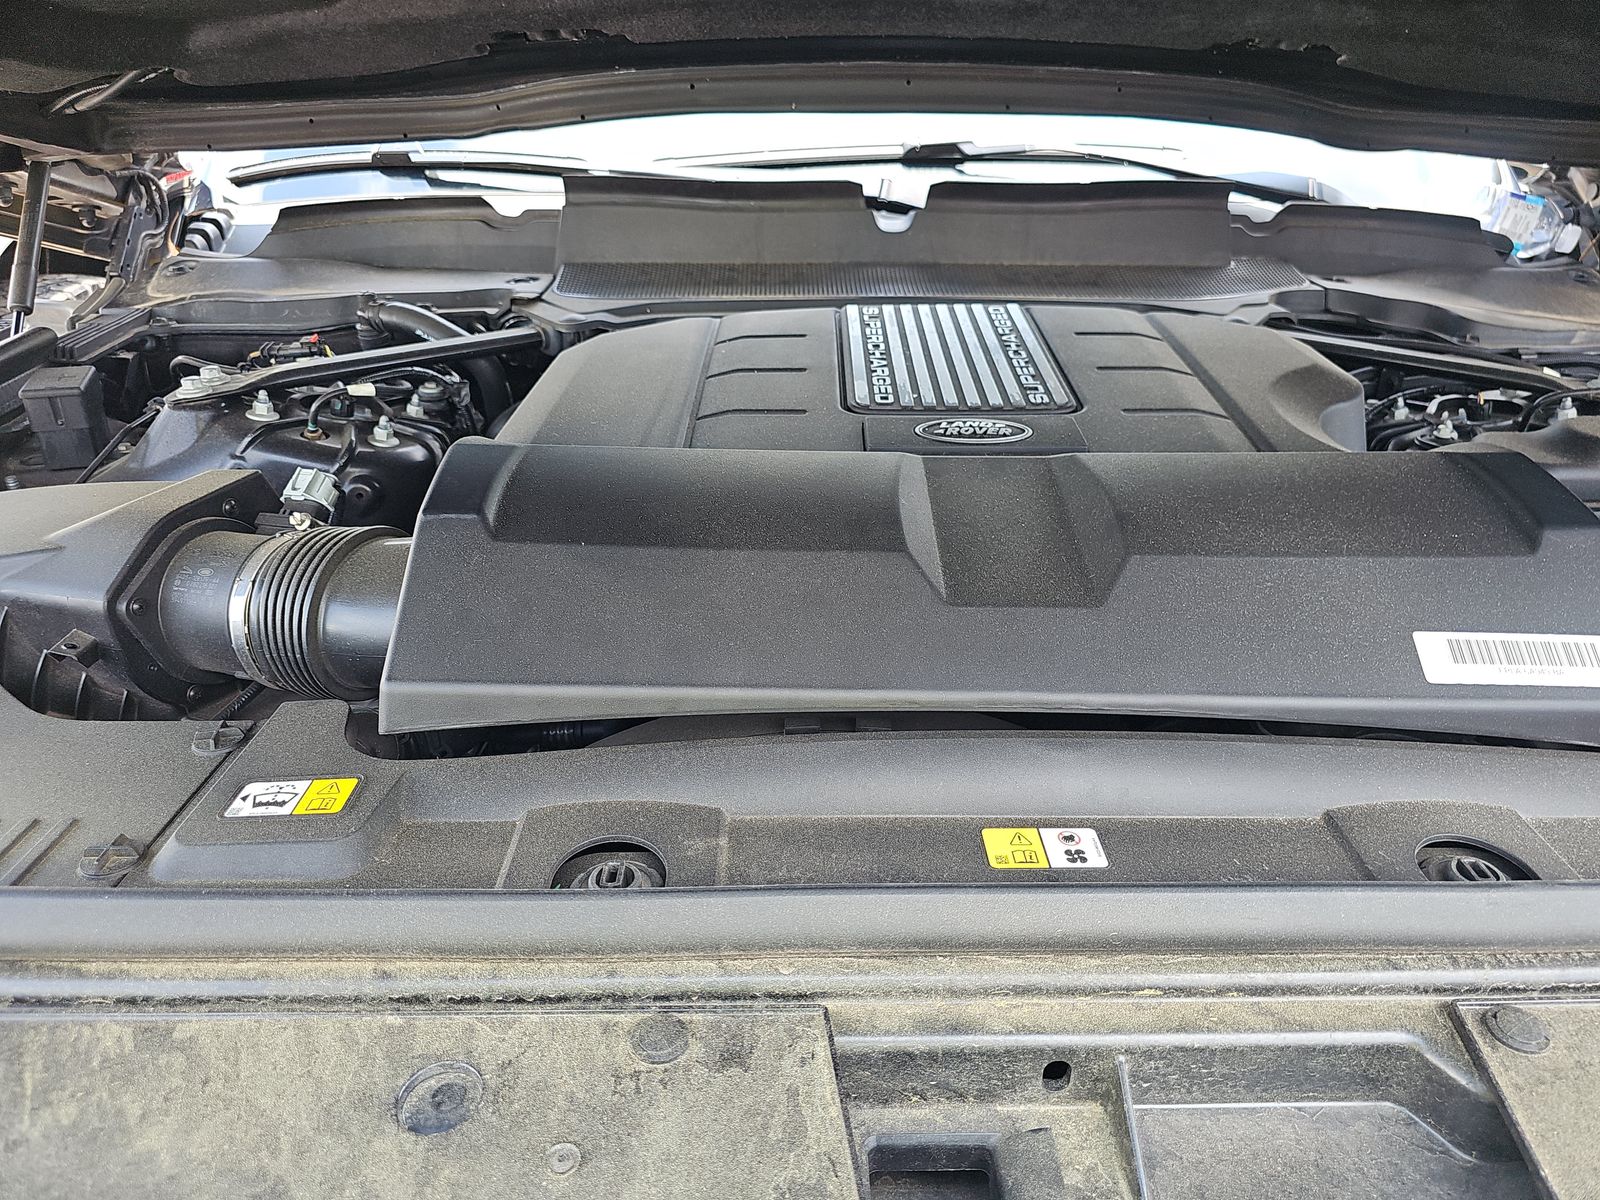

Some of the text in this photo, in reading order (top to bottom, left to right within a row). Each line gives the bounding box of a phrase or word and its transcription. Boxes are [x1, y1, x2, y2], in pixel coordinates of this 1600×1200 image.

[862, 305, 895, 404] SUPERCHARGED
[988, 305, 1049, 405] SUPERCHARGED
[945, 427, 1013, 436] ROVER
